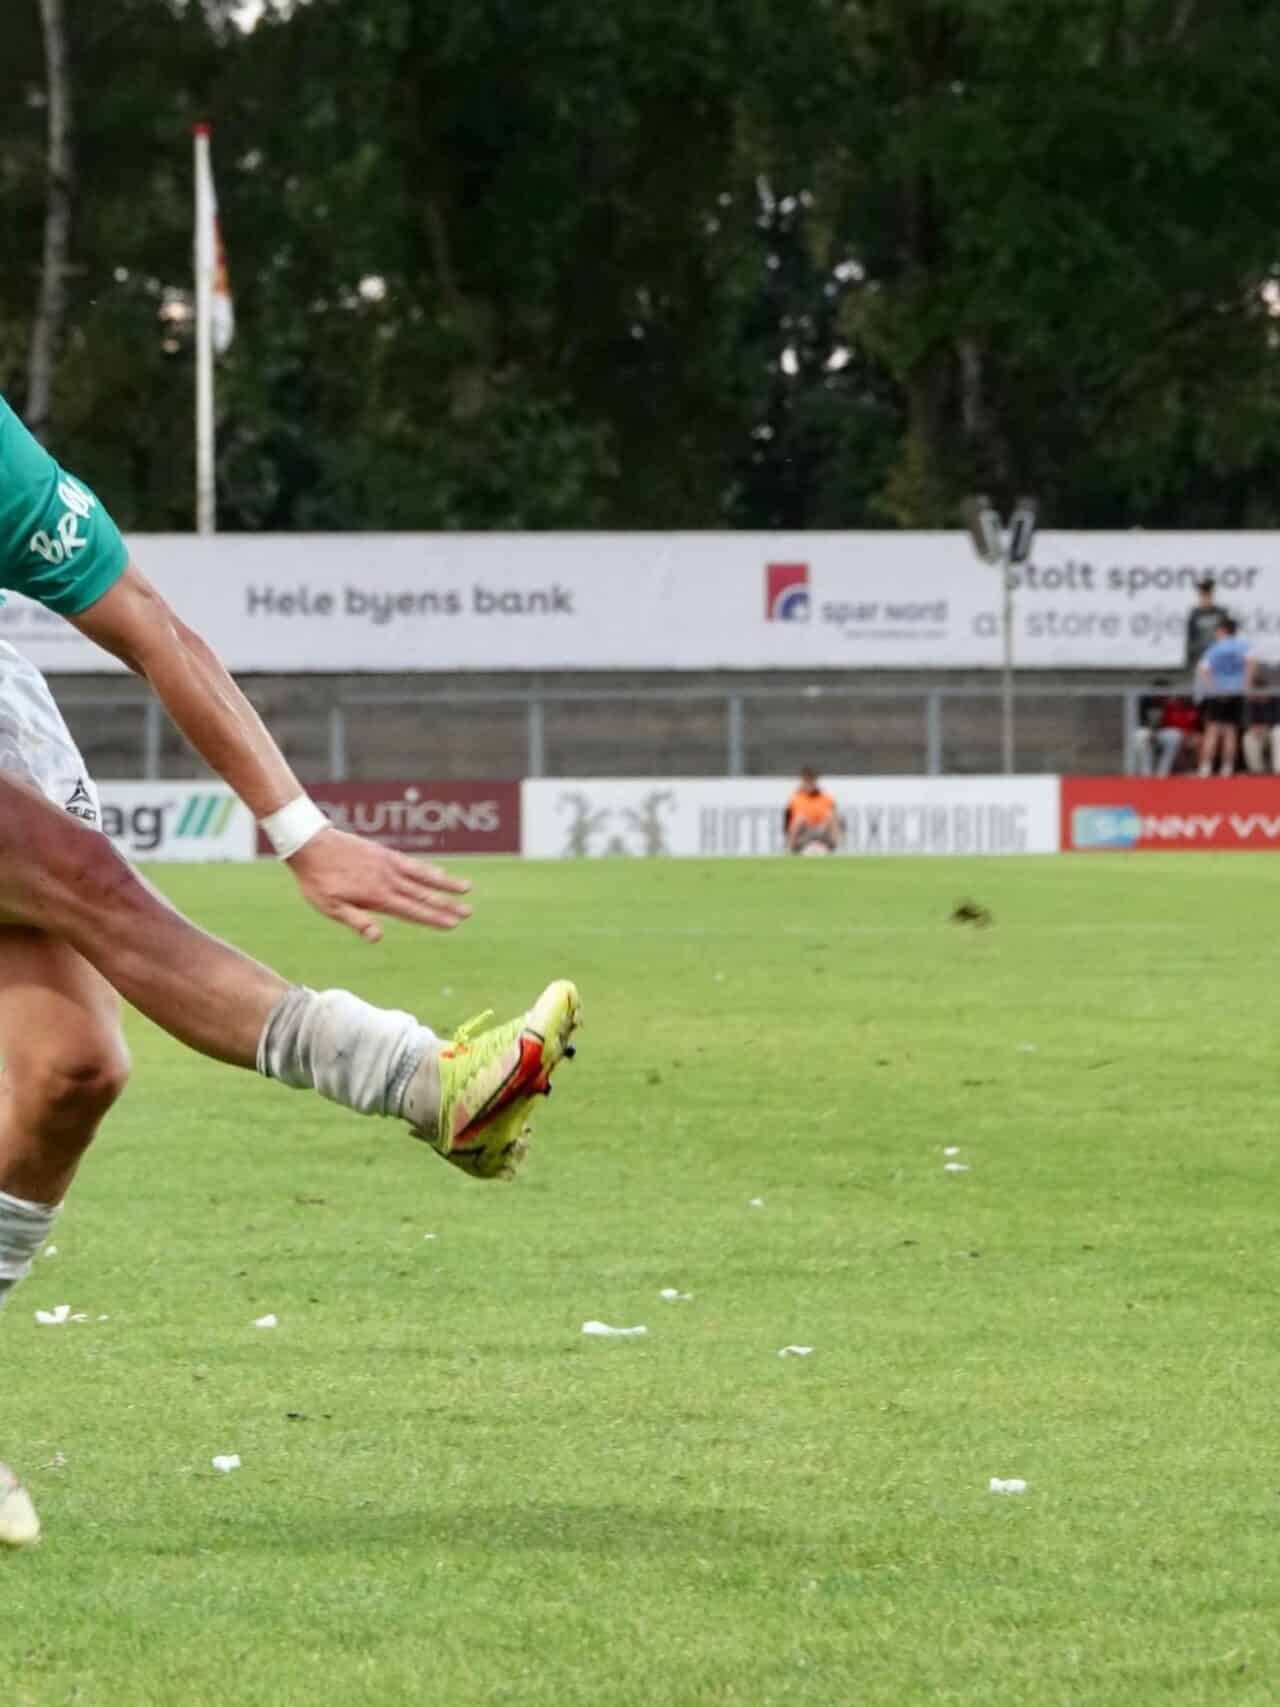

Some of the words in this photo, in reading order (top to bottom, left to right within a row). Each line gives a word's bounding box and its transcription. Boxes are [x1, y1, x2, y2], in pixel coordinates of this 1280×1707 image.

[246, 584, 334, 617] Hele
[343, 585, 462, 626] byens
[471, 581, 575, 615] bank
[1026, 609, 1121, 638] store
